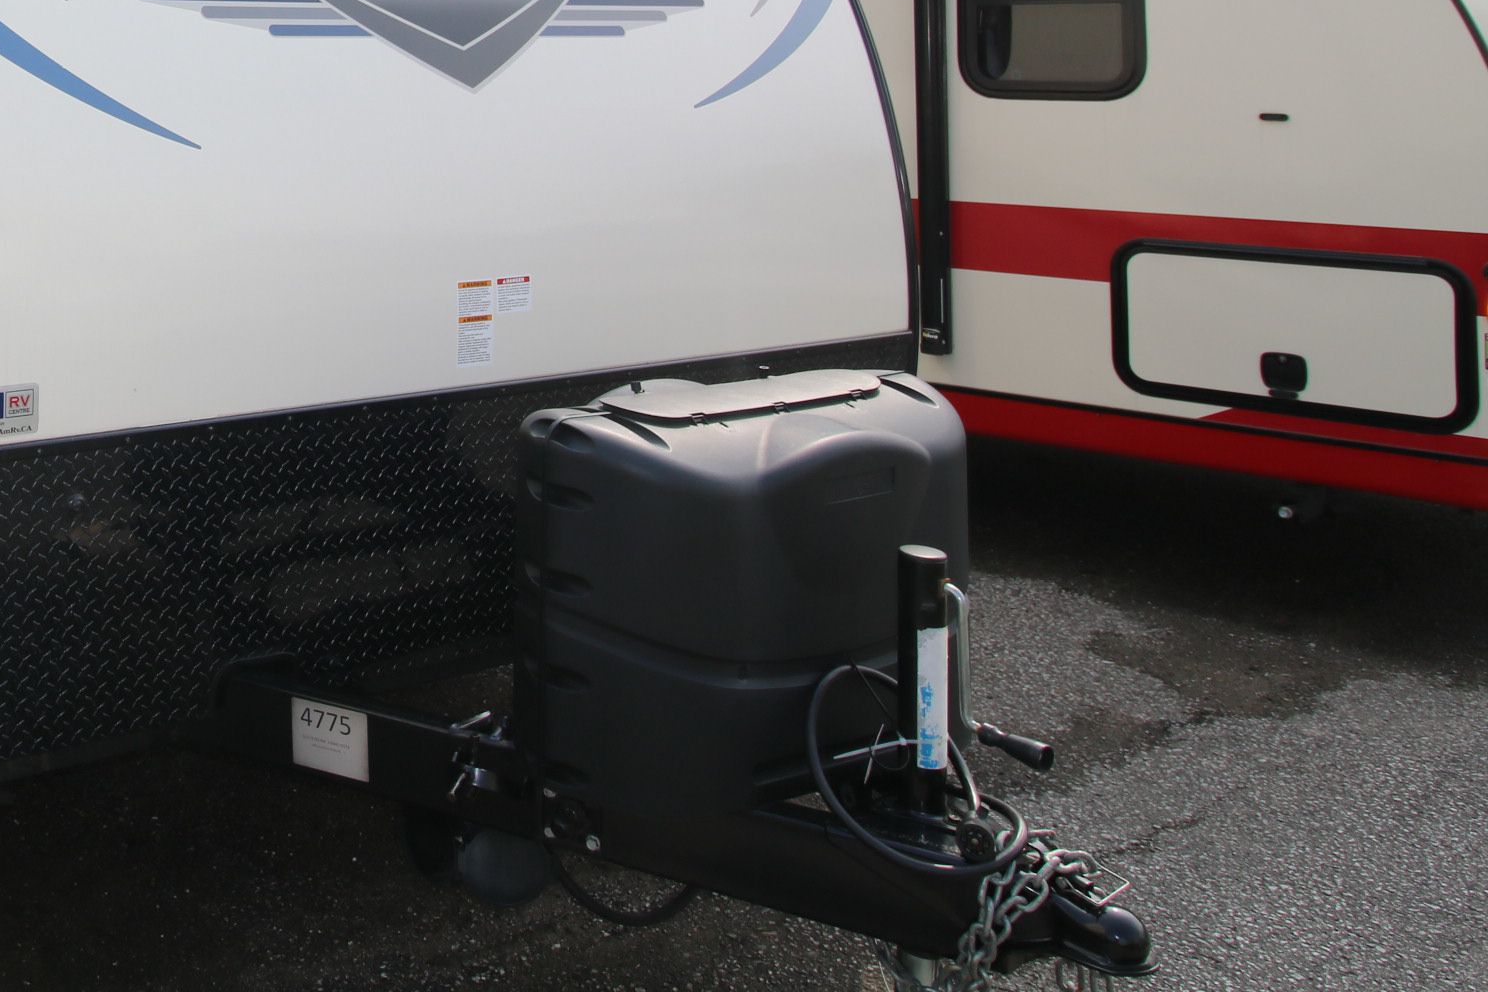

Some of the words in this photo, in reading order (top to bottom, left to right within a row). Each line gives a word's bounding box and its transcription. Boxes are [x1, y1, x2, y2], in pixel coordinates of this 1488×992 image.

[9, 394, 32, 408] RV
[8, 407, 30, 415] CENTRE
[300, 707, 351, 736] 4775
